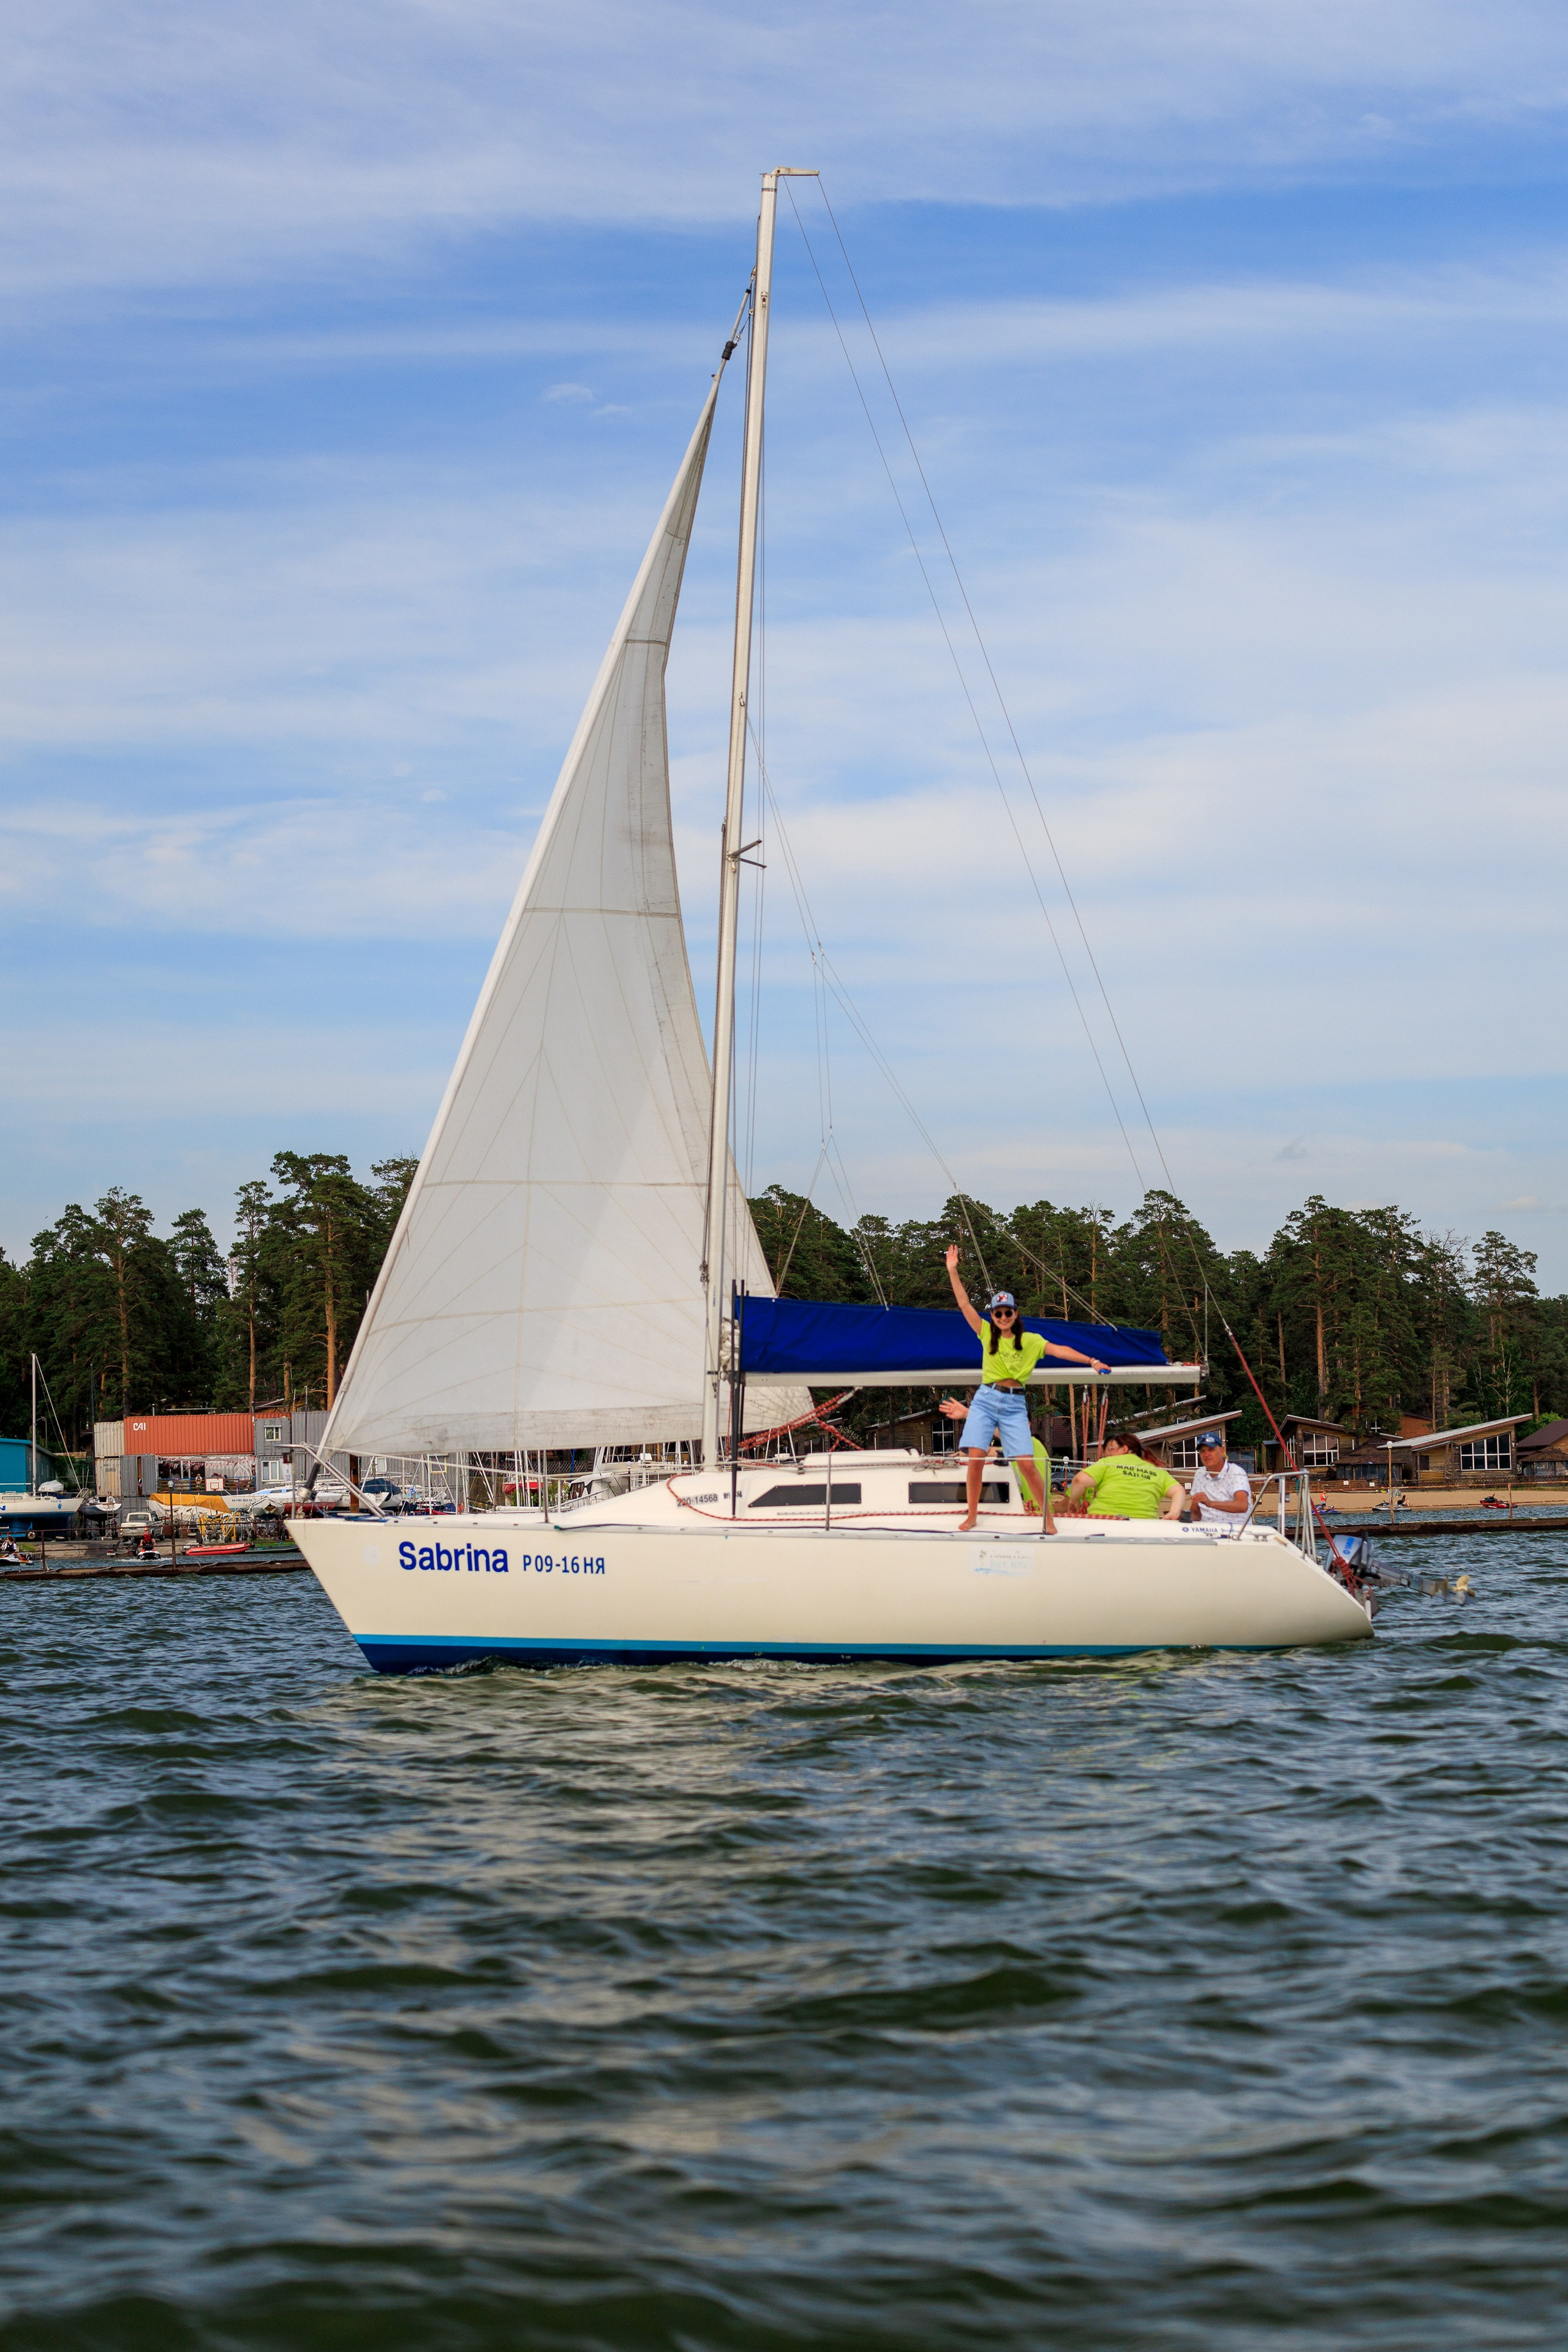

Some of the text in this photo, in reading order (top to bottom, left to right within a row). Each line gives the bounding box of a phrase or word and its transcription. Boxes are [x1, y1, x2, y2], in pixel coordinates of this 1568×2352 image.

[133, 1422, 146, 1431] CAI
[1123, 1471, 1151, 1480] SAILOR
[1137, 1468, 1157, 1477] MASS
[399, 1541, 509, 1572] Sabrina
